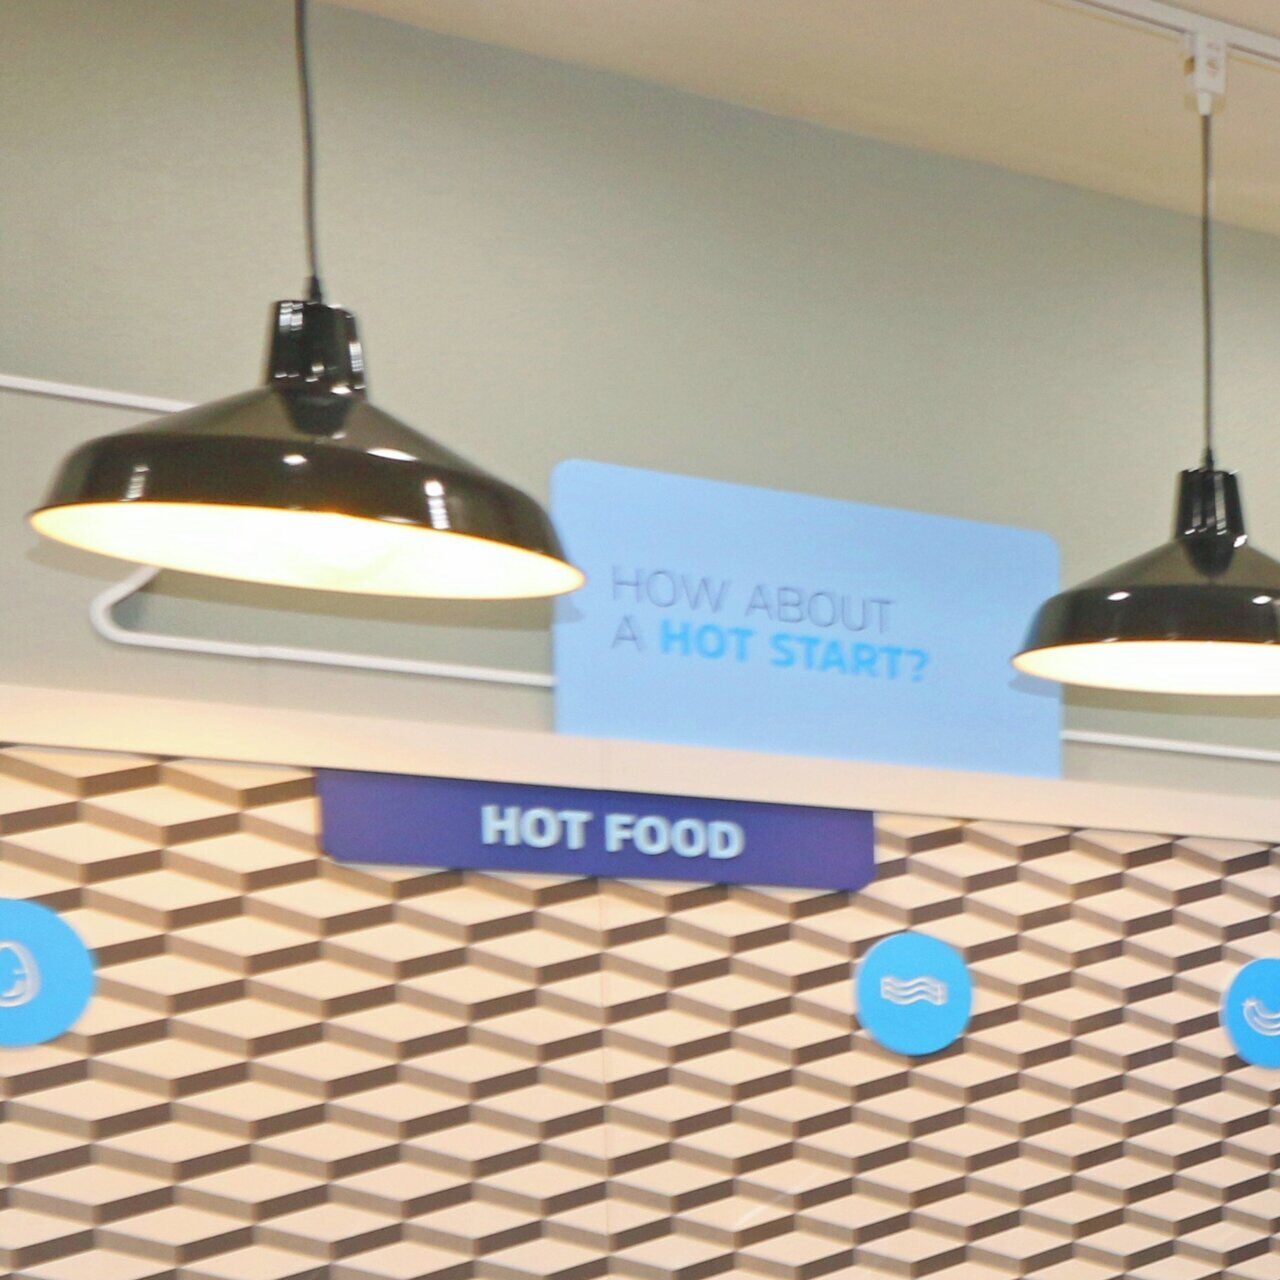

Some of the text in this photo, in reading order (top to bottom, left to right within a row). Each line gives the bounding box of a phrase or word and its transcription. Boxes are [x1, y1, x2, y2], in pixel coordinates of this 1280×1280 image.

[611, 566, 897, 635] HOW ABOUT
[612, 615, 930, 682] A HOT START?
[481, 804, 745, 861] HOT FOOD
